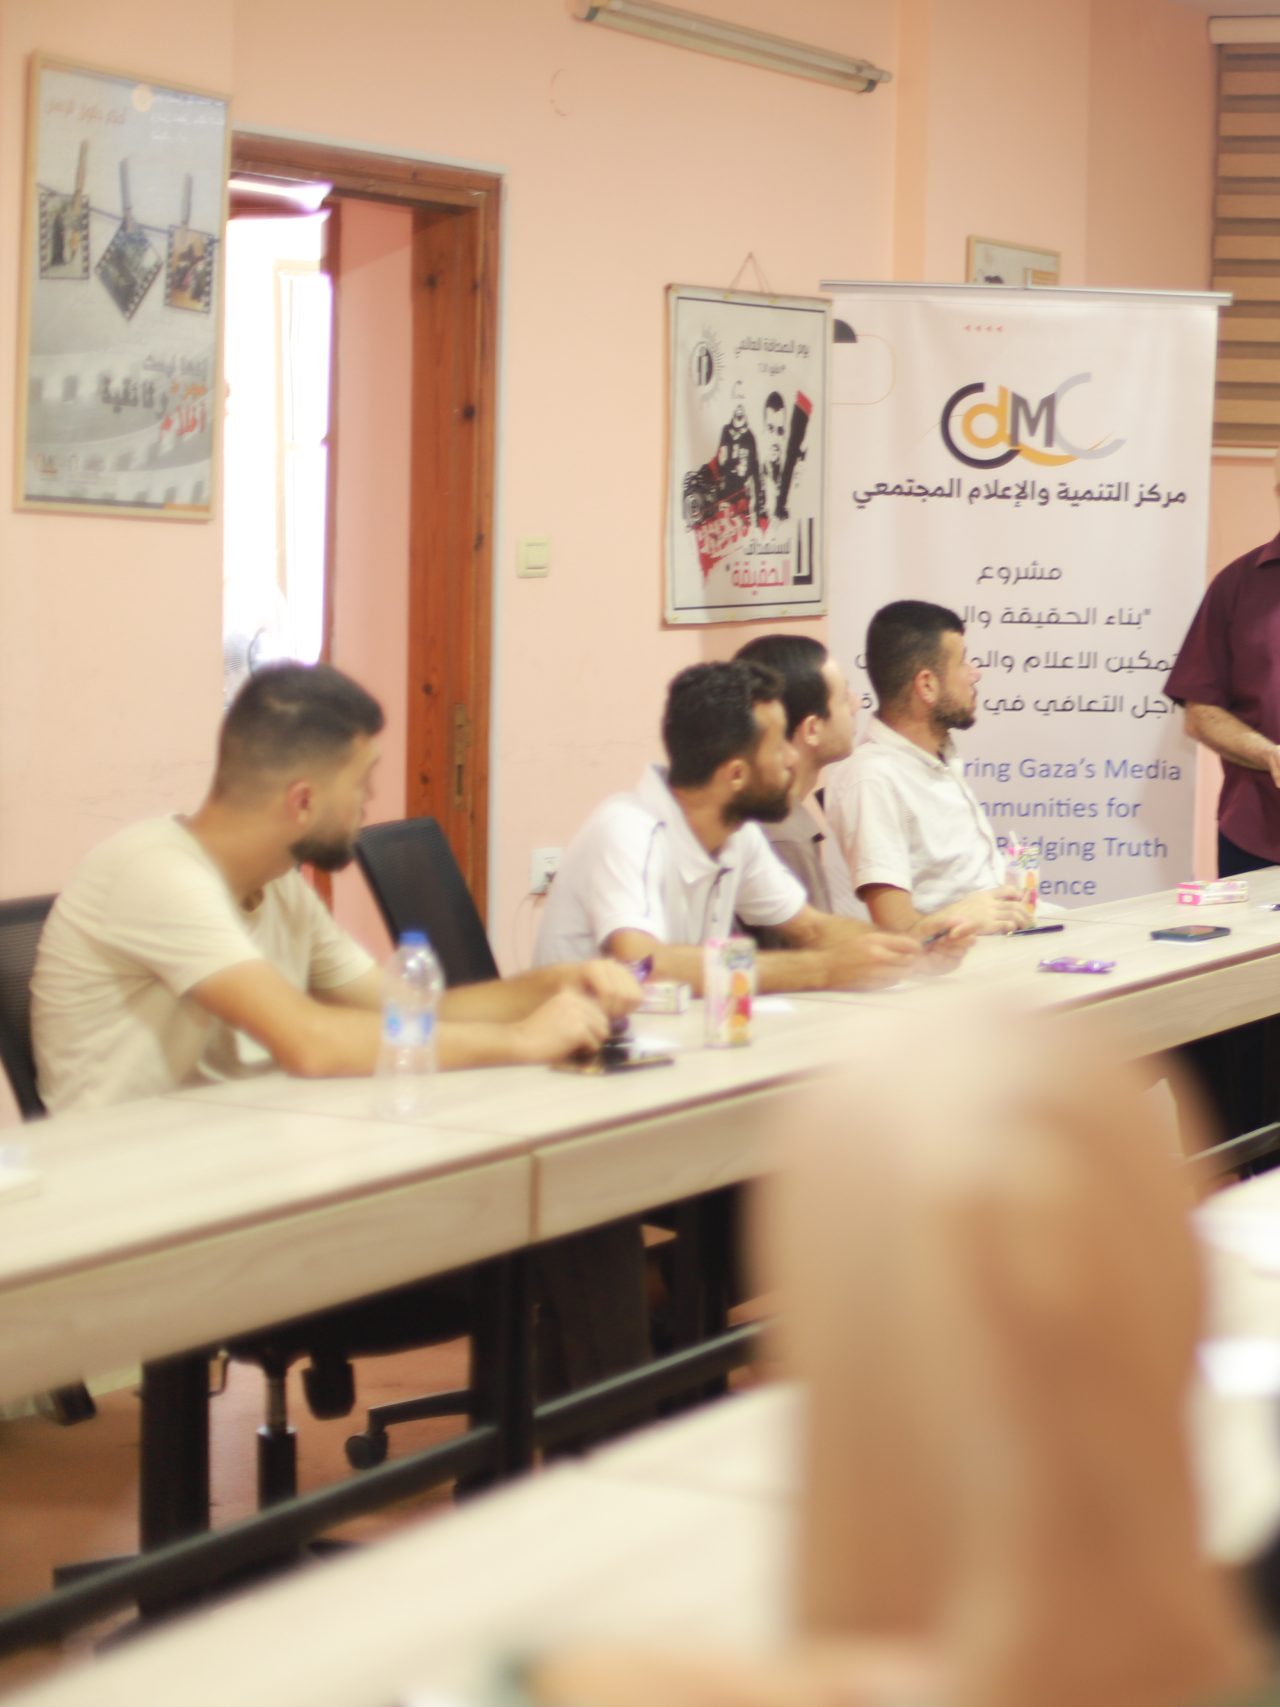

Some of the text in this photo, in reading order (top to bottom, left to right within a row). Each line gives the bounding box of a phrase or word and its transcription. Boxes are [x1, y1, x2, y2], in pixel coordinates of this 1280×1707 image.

[852, 477, 1188, 510] مركز التنمية والإعلام المجتمعي
[976, 560, 1063, 585] مشروع
[999, 606, 1098, 629] الحقيقة
[982, 694, 1026, 716] في
[1033, 694, 1124, 716] التعافي
[1103, 758, 1182, 781] Media
[1106, 797, 1142, 819] for
[1103, 836, 1168, 859] Truth
